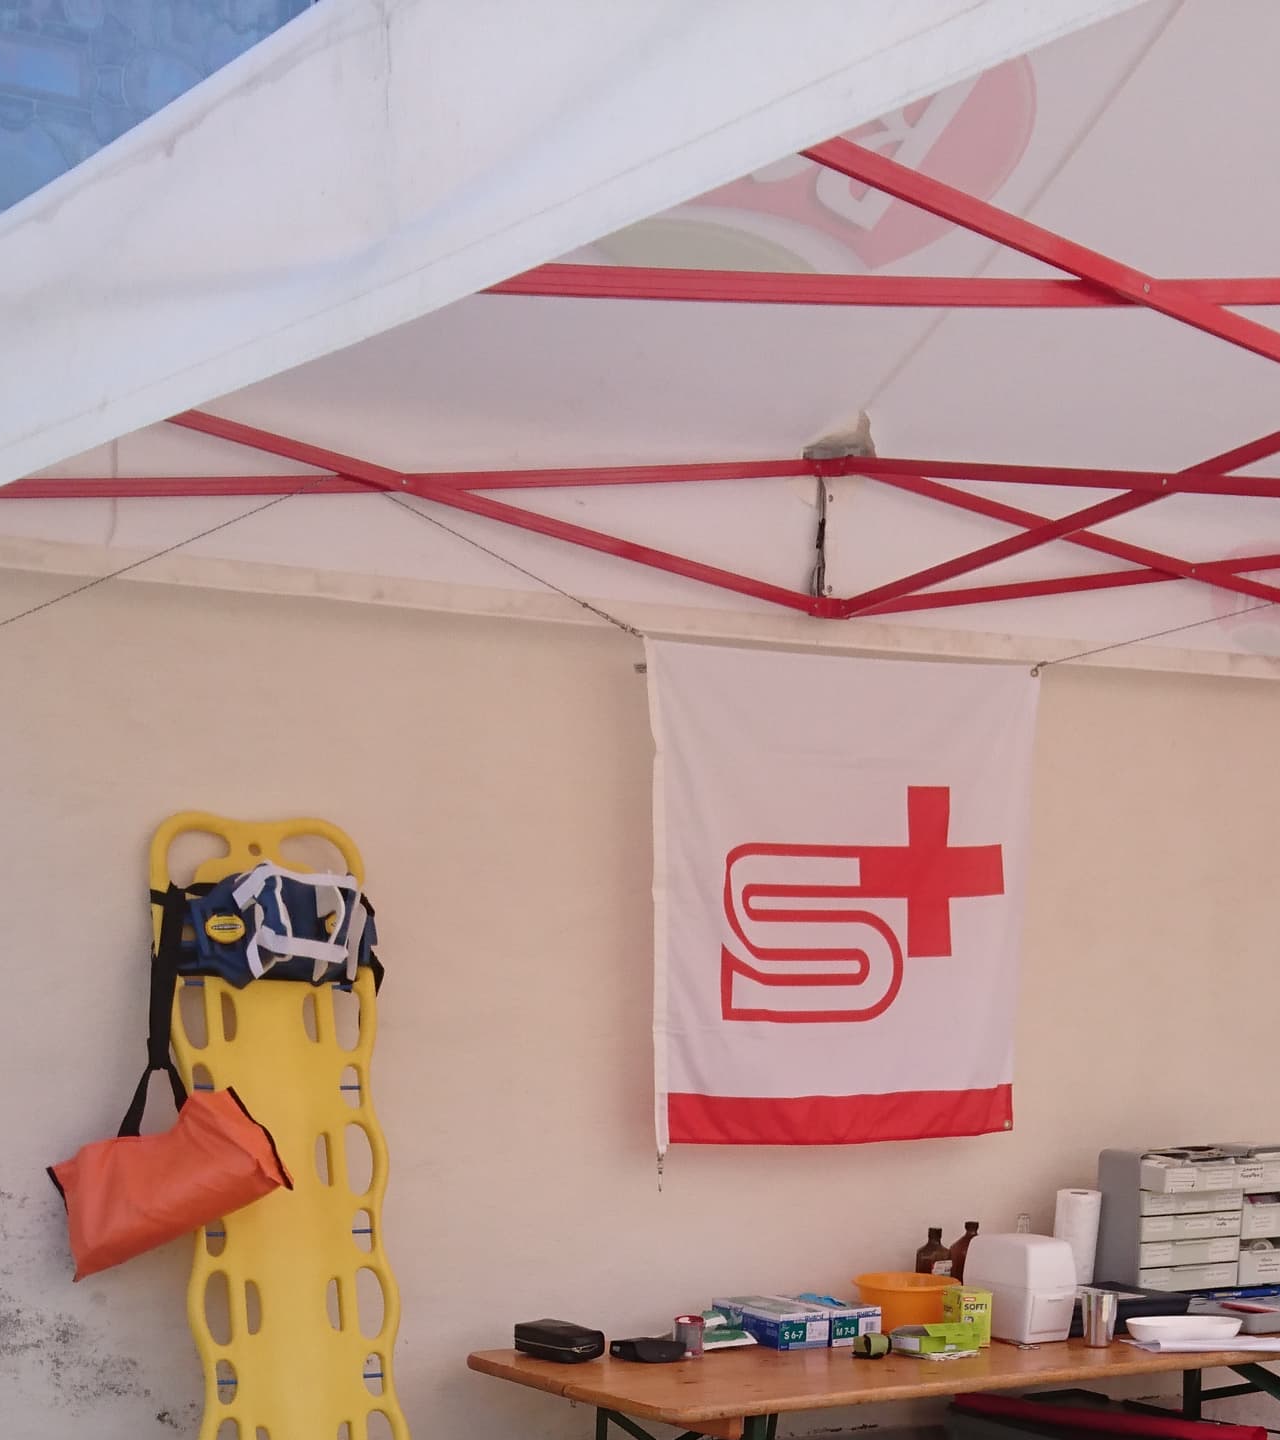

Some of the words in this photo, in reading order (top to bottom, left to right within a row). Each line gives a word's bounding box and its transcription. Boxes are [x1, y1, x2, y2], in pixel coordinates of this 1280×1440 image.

[784, 1331, 790, 1340] S
[791, 1330, 804, 1339] 6-7
[836, 1328, 842, 1336] M
[844, 1327, 855, 1335] 7-8
